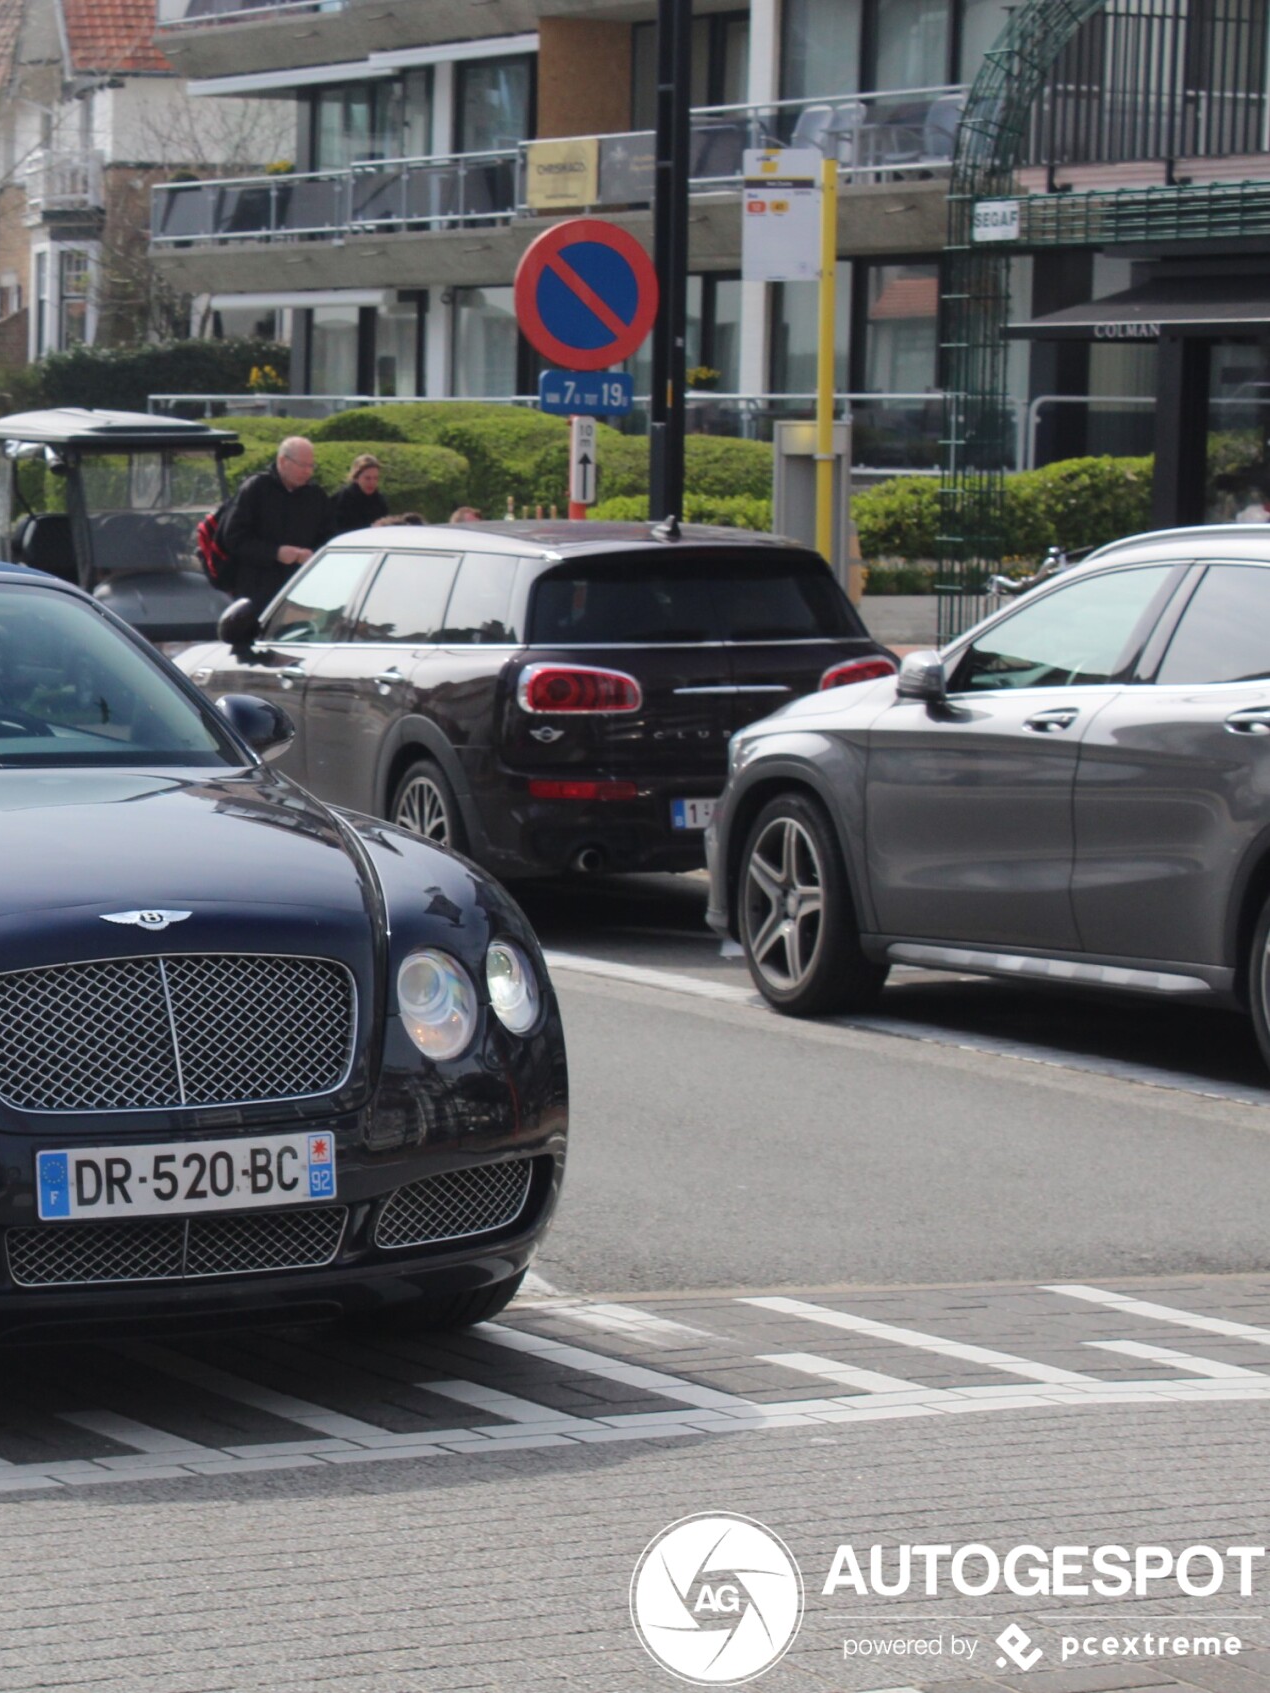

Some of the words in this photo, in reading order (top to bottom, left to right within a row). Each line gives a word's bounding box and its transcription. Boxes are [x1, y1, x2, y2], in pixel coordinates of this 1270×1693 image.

[1094, 324, 1160, 338] COLMAN
[311, 1170, 332, 1192] 92
[50, 1190, 60, 1206] F
